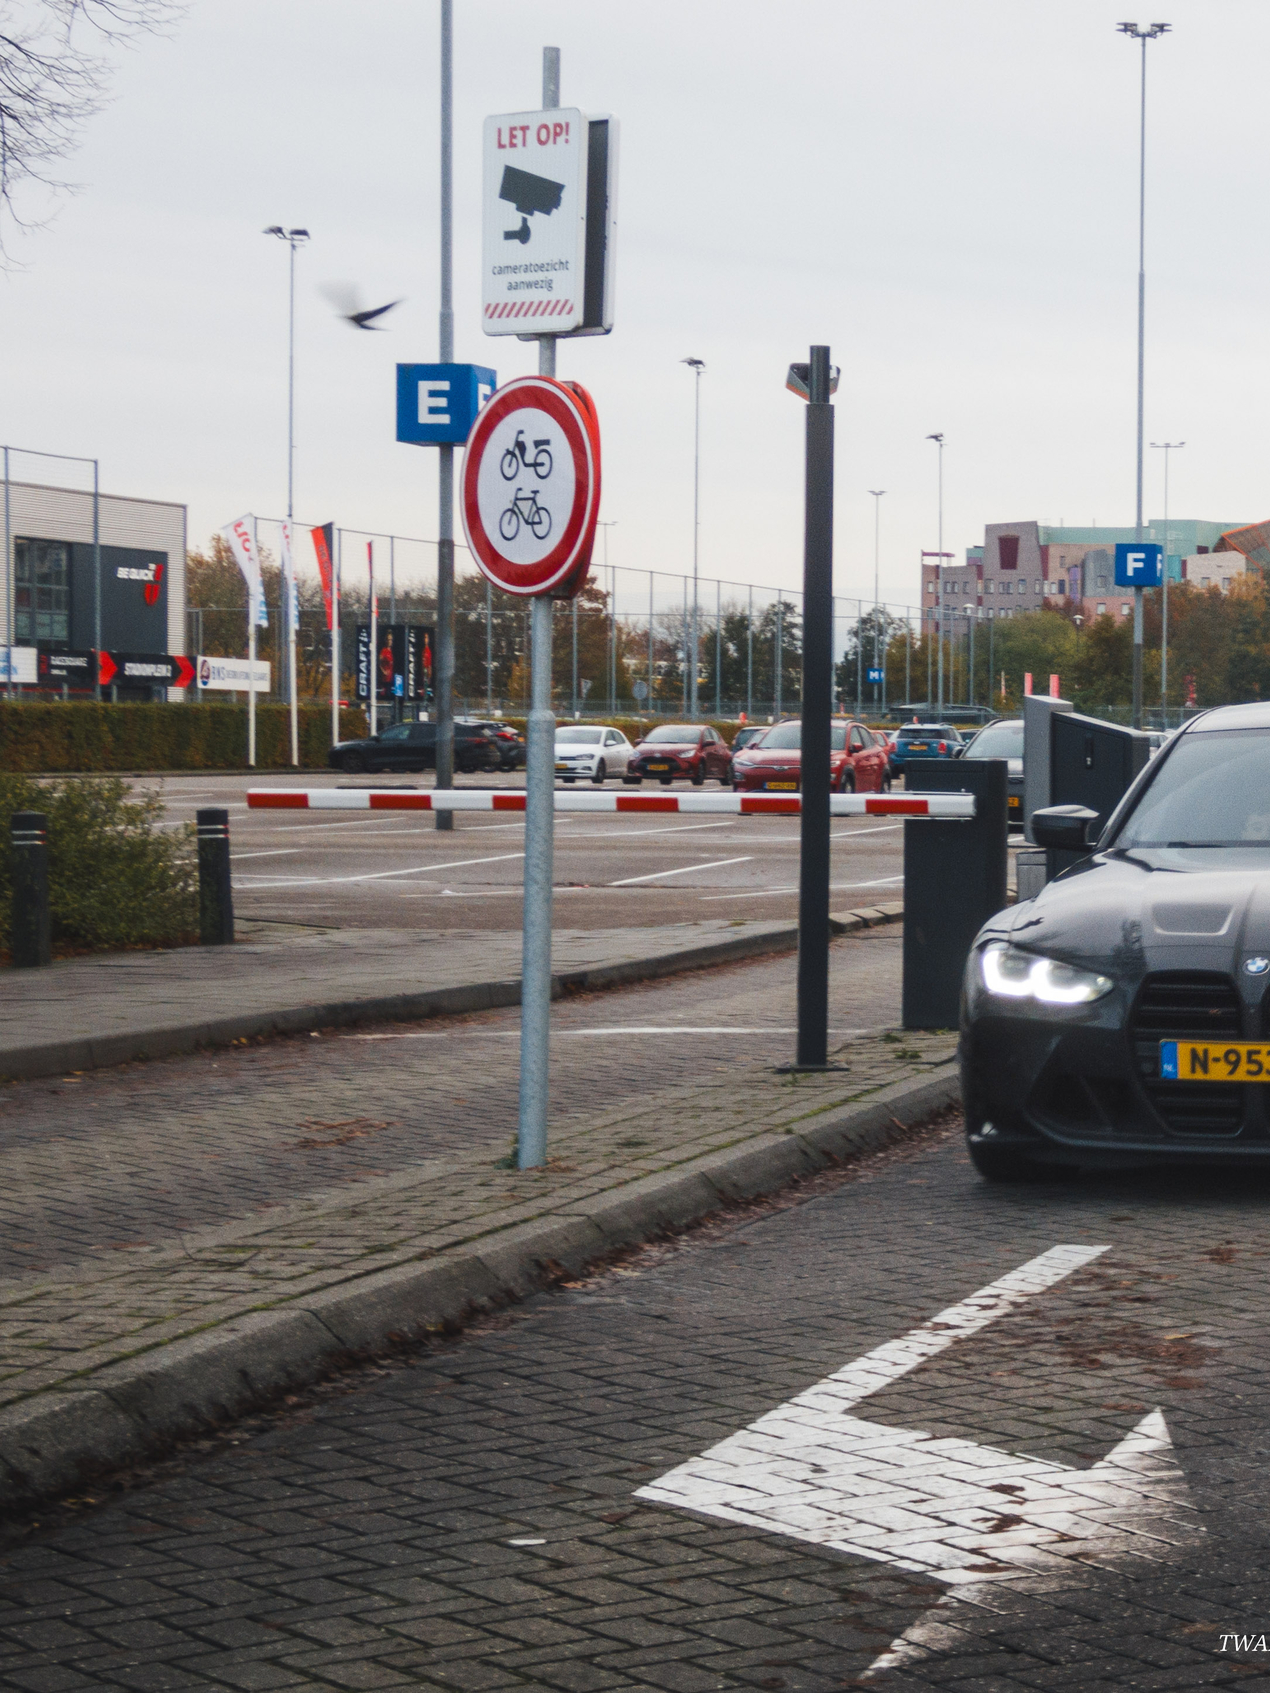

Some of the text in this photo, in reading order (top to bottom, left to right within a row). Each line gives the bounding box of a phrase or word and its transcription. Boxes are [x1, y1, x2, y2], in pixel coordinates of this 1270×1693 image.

[497, 122, 570, 149] LET OP!
[492, 259, 570, 275] cameratoezicht
[507, 277, 554, 292] aanwezig
[417, 380, 451, 424] E
[1126, 552, 1146, 577] F
[359, 643, 368, 697] CRAFT
[869, 670, 880, 680] M
